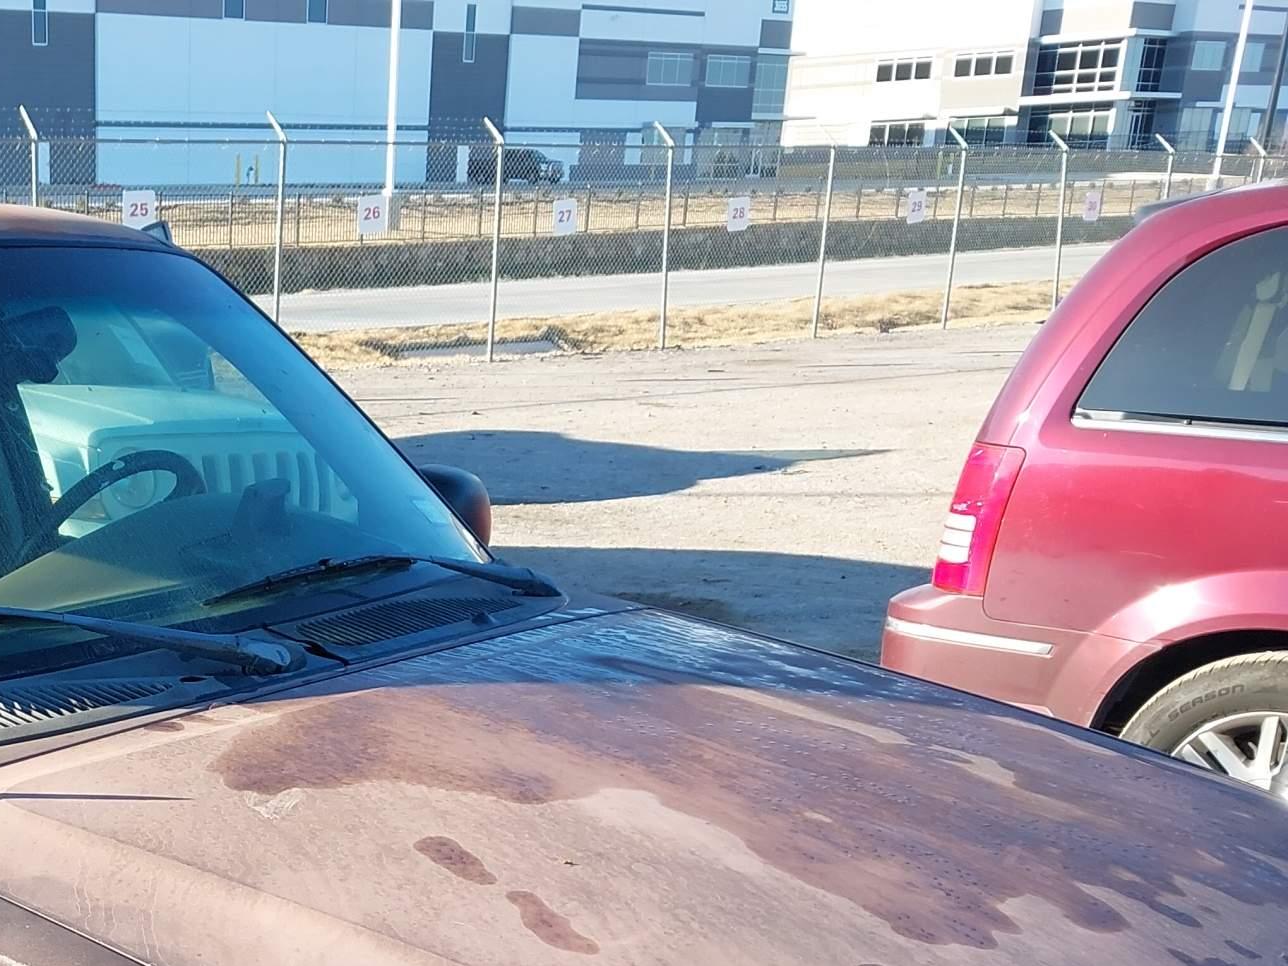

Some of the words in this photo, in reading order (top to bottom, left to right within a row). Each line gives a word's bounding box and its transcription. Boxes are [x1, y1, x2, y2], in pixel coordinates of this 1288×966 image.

[129, 202, 149, 217] 25
[363, 206, 381, 221] 26
[732, 207, 745, 219] 28
[911, 200, 923, 213] 29
[558, 209, 572, 223] 27
[1167, 683, 1245, 722] SEASON
